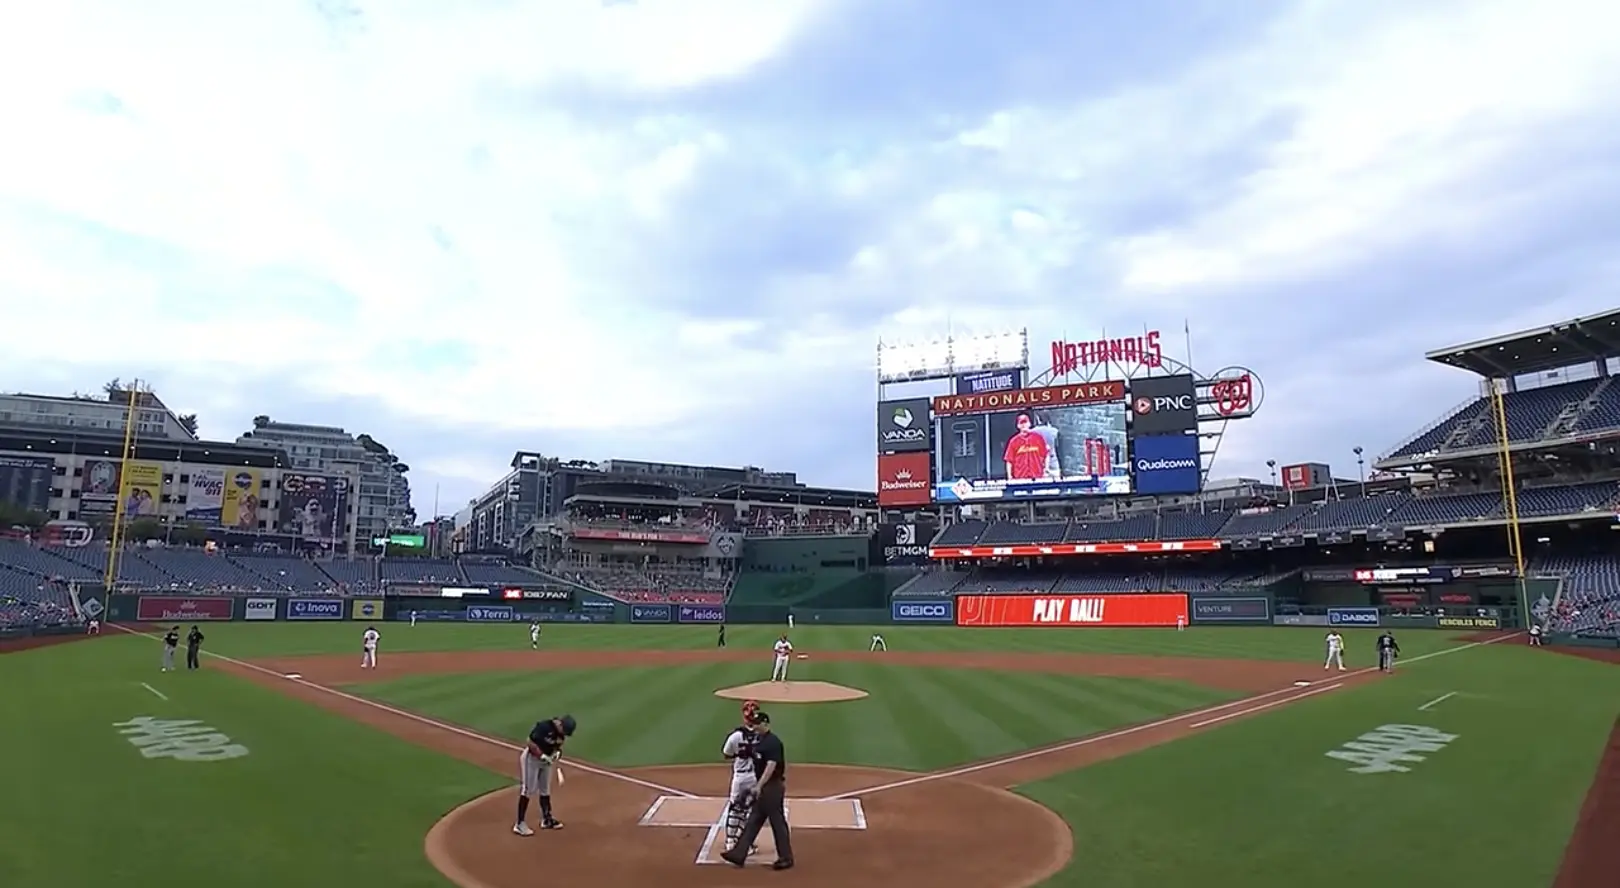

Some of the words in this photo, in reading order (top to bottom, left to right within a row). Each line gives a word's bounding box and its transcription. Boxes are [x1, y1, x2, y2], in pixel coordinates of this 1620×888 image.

[1050, 331, 1160, 375] NATIONALS
[972, 374, 1012, 391] NATITUDE
[940, 391, 1050, 410] NATIONALS
[1062, 385, 1114, 399] PARK
[1154, 395, 1191, 411] PNC
[1137, 459, 1195, 470] Qualcomm
[194, 480, 223, 489] HVAC
[881, 480, 926, 490] Budweiser
[205, 488, 221, 496] 911
[884, 546, 927, 556] BETMGM
[546, 591, 568, 599] FAN
[306, 602, 336, 612] Inova
[900, 605, 945, 616] GEICO
[1033, 598, 1065, 622] PLAY
[1070, 598, 1105, 622] BALL!
[161, 610, 209, 620] Budweiser
[483, 610, 509, 619] Terra
[694, 610, 723, 620] leidos
